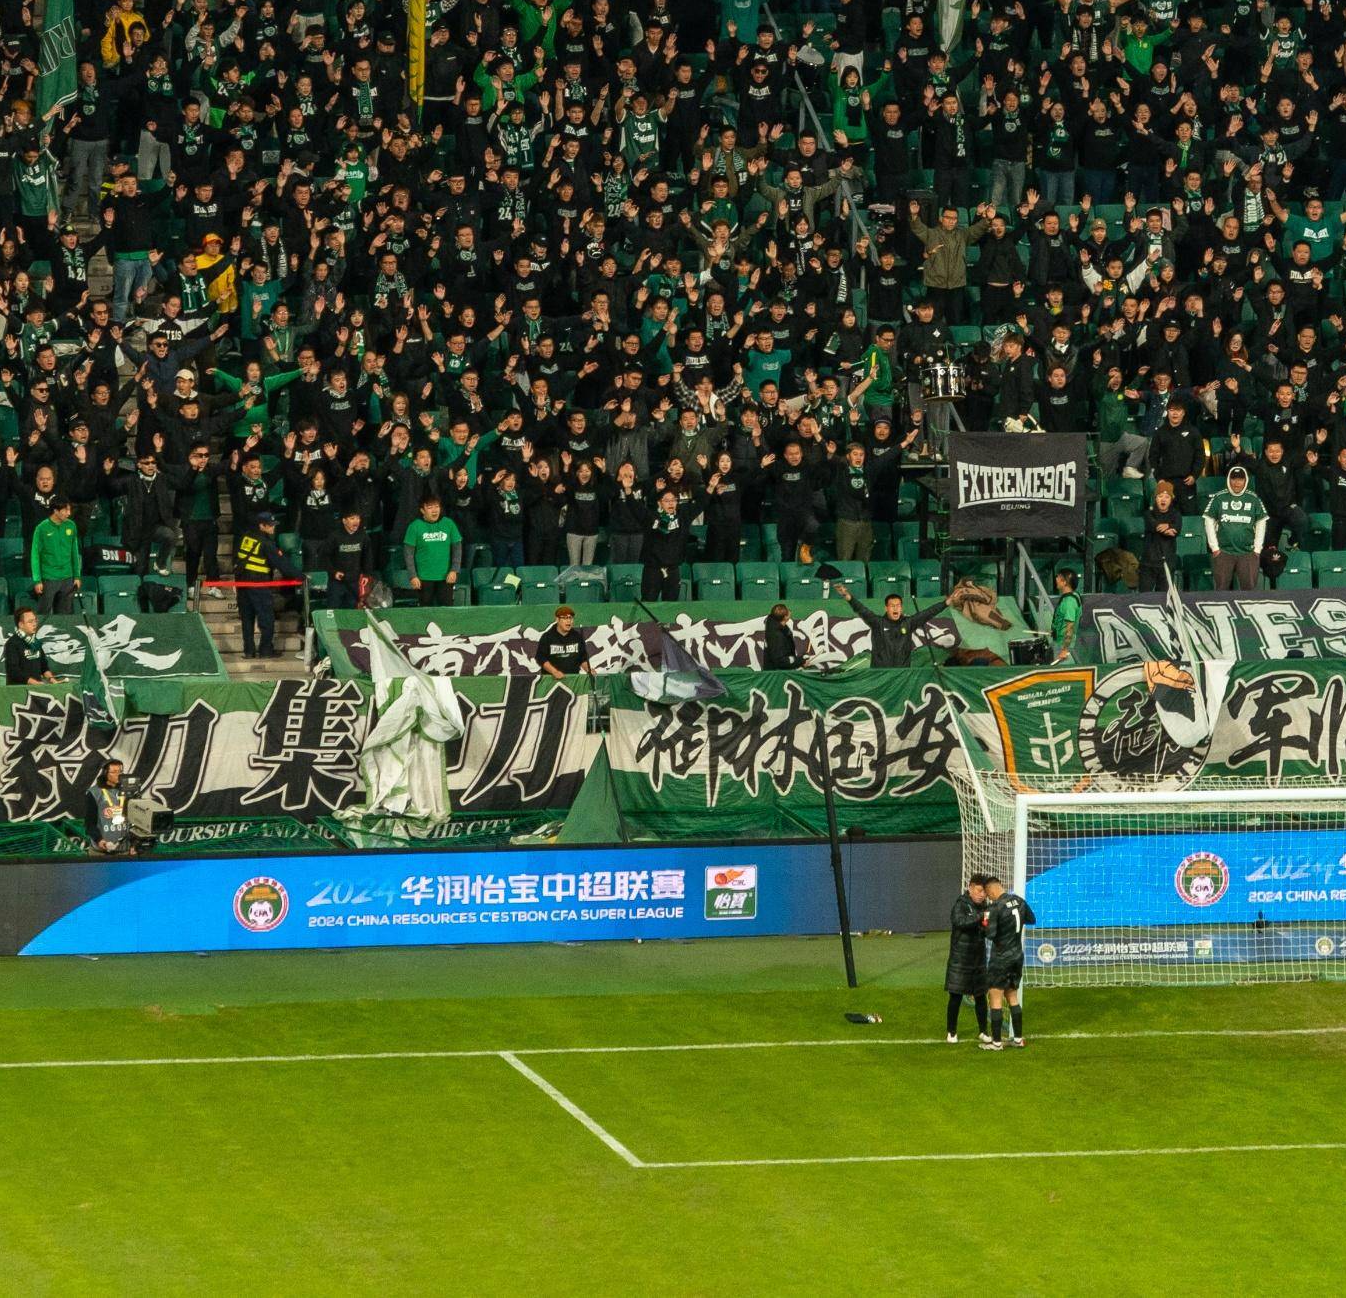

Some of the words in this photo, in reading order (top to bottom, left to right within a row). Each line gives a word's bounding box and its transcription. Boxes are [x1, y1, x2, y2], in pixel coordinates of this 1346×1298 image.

[956, 460, 1077, 510] EXTREME90S
[157, 820, 251, 845] OURSELF
[308, 915, 344, 928] 2024
[347, 913, 390, 927] CHINA
[392, 911, 476, 925] RESOURCES
[479, 909, 548, 923] C'ESTBON
[551, 908, 578, 921] CFA
[580, 908, 627, 920] SUPER
[629, 906, 684, 919] LEAGUE
